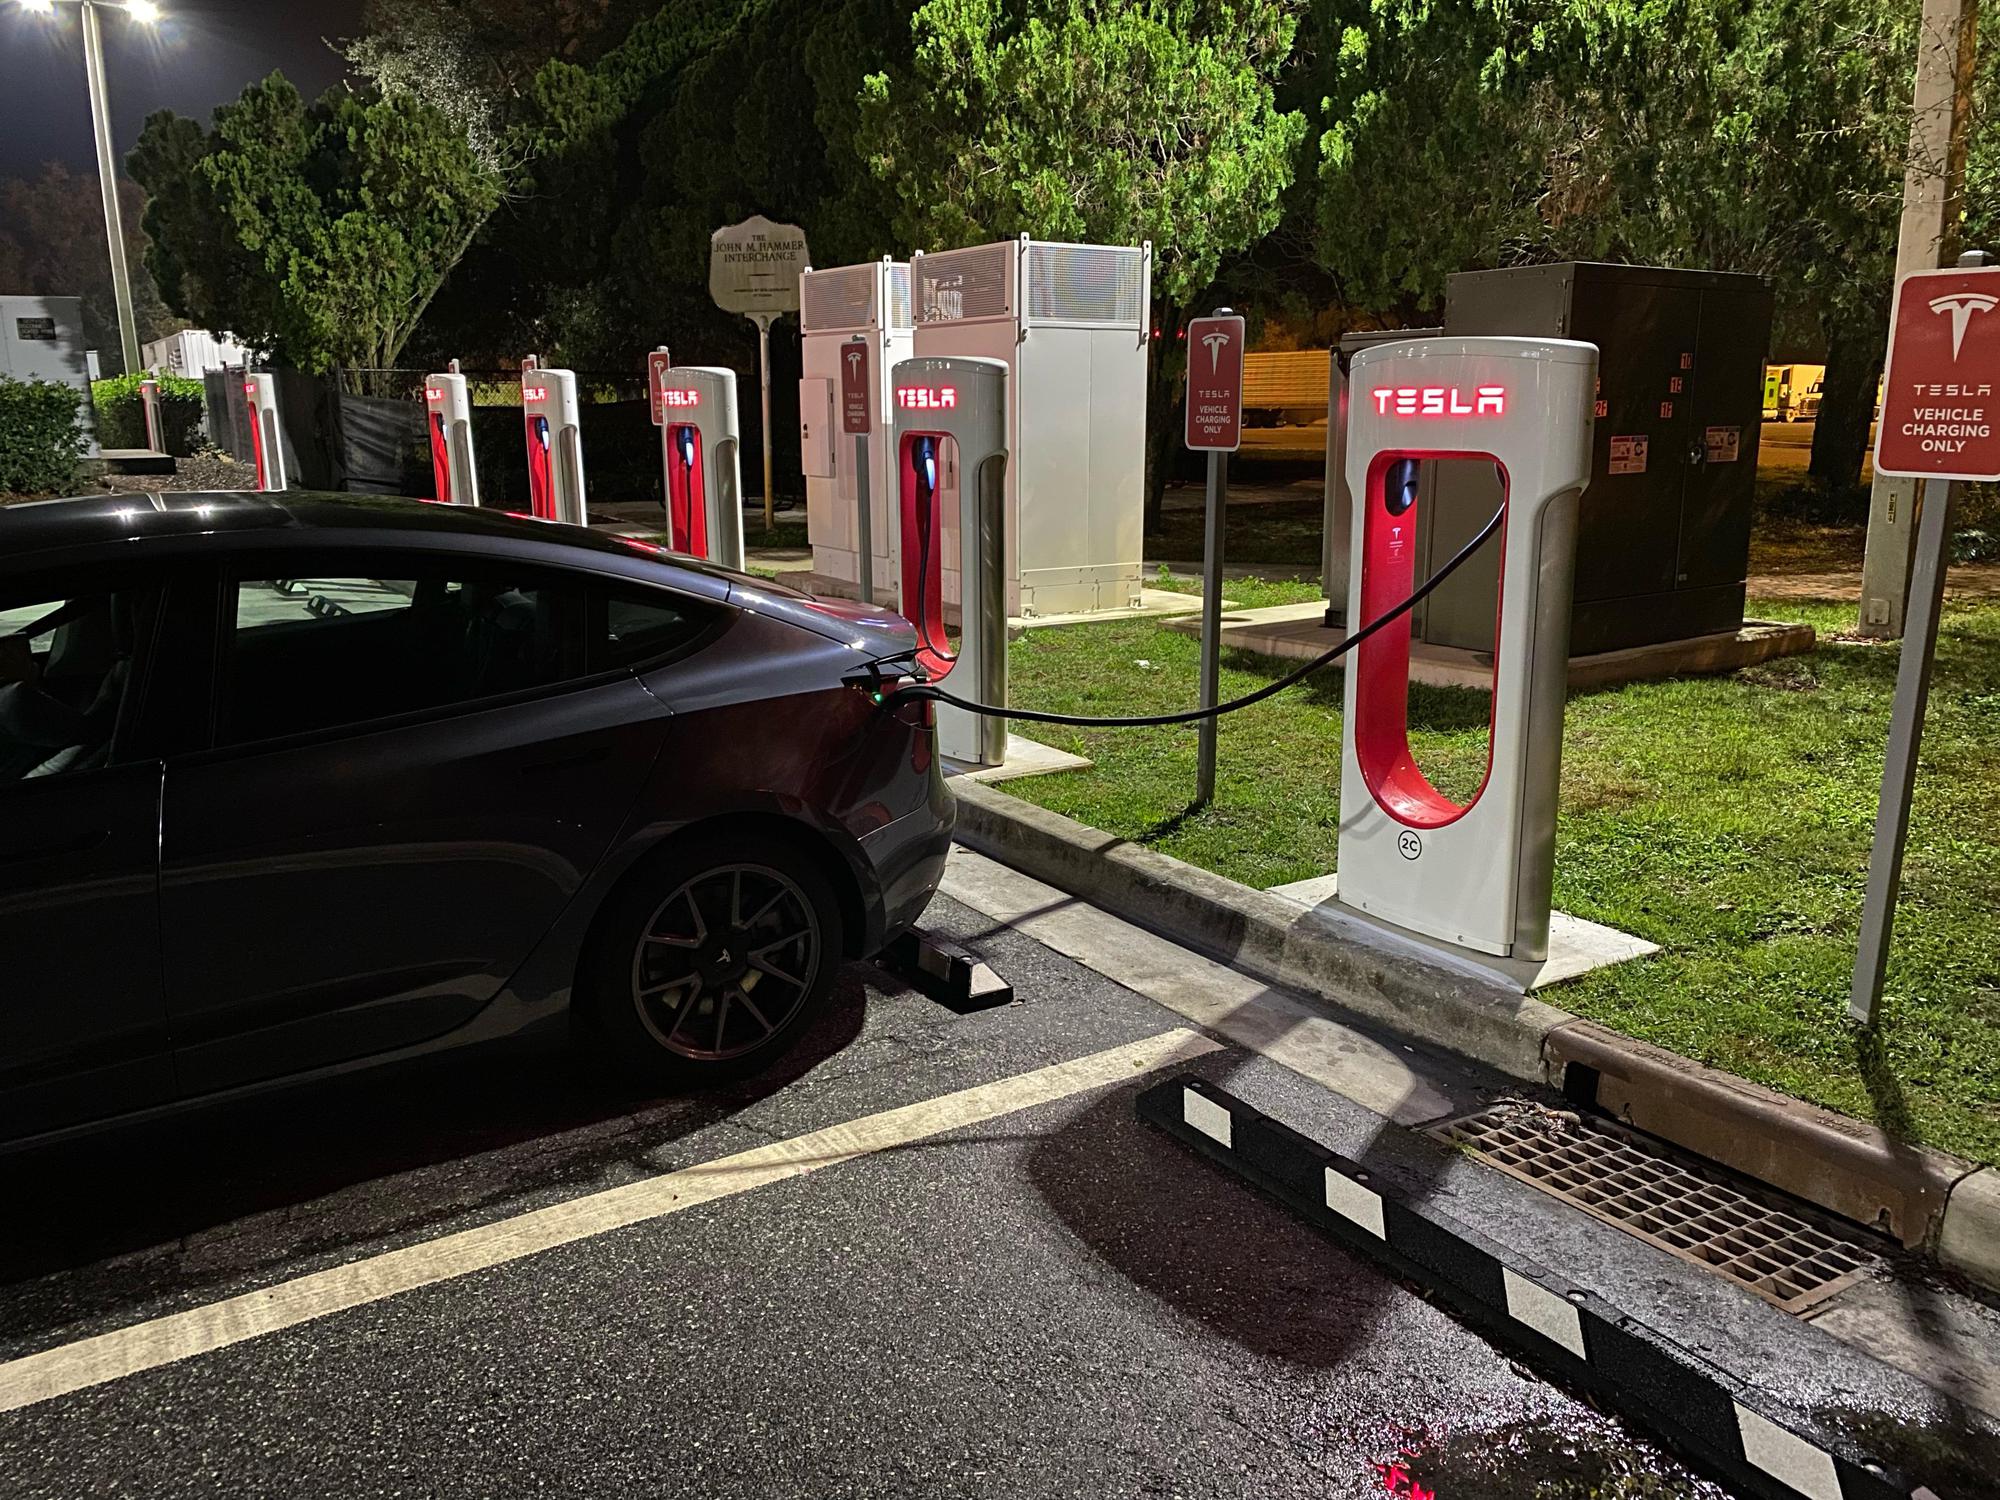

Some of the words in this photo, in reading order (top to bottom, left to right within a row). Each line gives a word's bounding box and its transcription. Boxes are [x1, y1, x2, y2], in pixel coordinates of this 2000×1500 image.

[714, 242, 742, 252] JOHN
[759, 241, 804, 252] HAMMER
[724, 251, 797, 263] INTERCHANGE
[1198, 390, 1230, 398] TESLA
[1913, 384, 1992, 396] TESLA
[663, 390, 697, 406] TESLA
[897, 388, 955, 408] TESLA
[1373, 387, 1504, 414] TESLA
[1199, 405, 1227, 414] VEHICLE
[1913, 408, 1984, 421] VEHICLE
[1195, 415, 1230, 424] CHARGING
[1203, 425, 1221, 434] ONLY
[1902, 424, 1990, 437] CHARGING
[1921, 439, 1967, 452] ONLY
[1401, 837, 1418, 852] 2C
